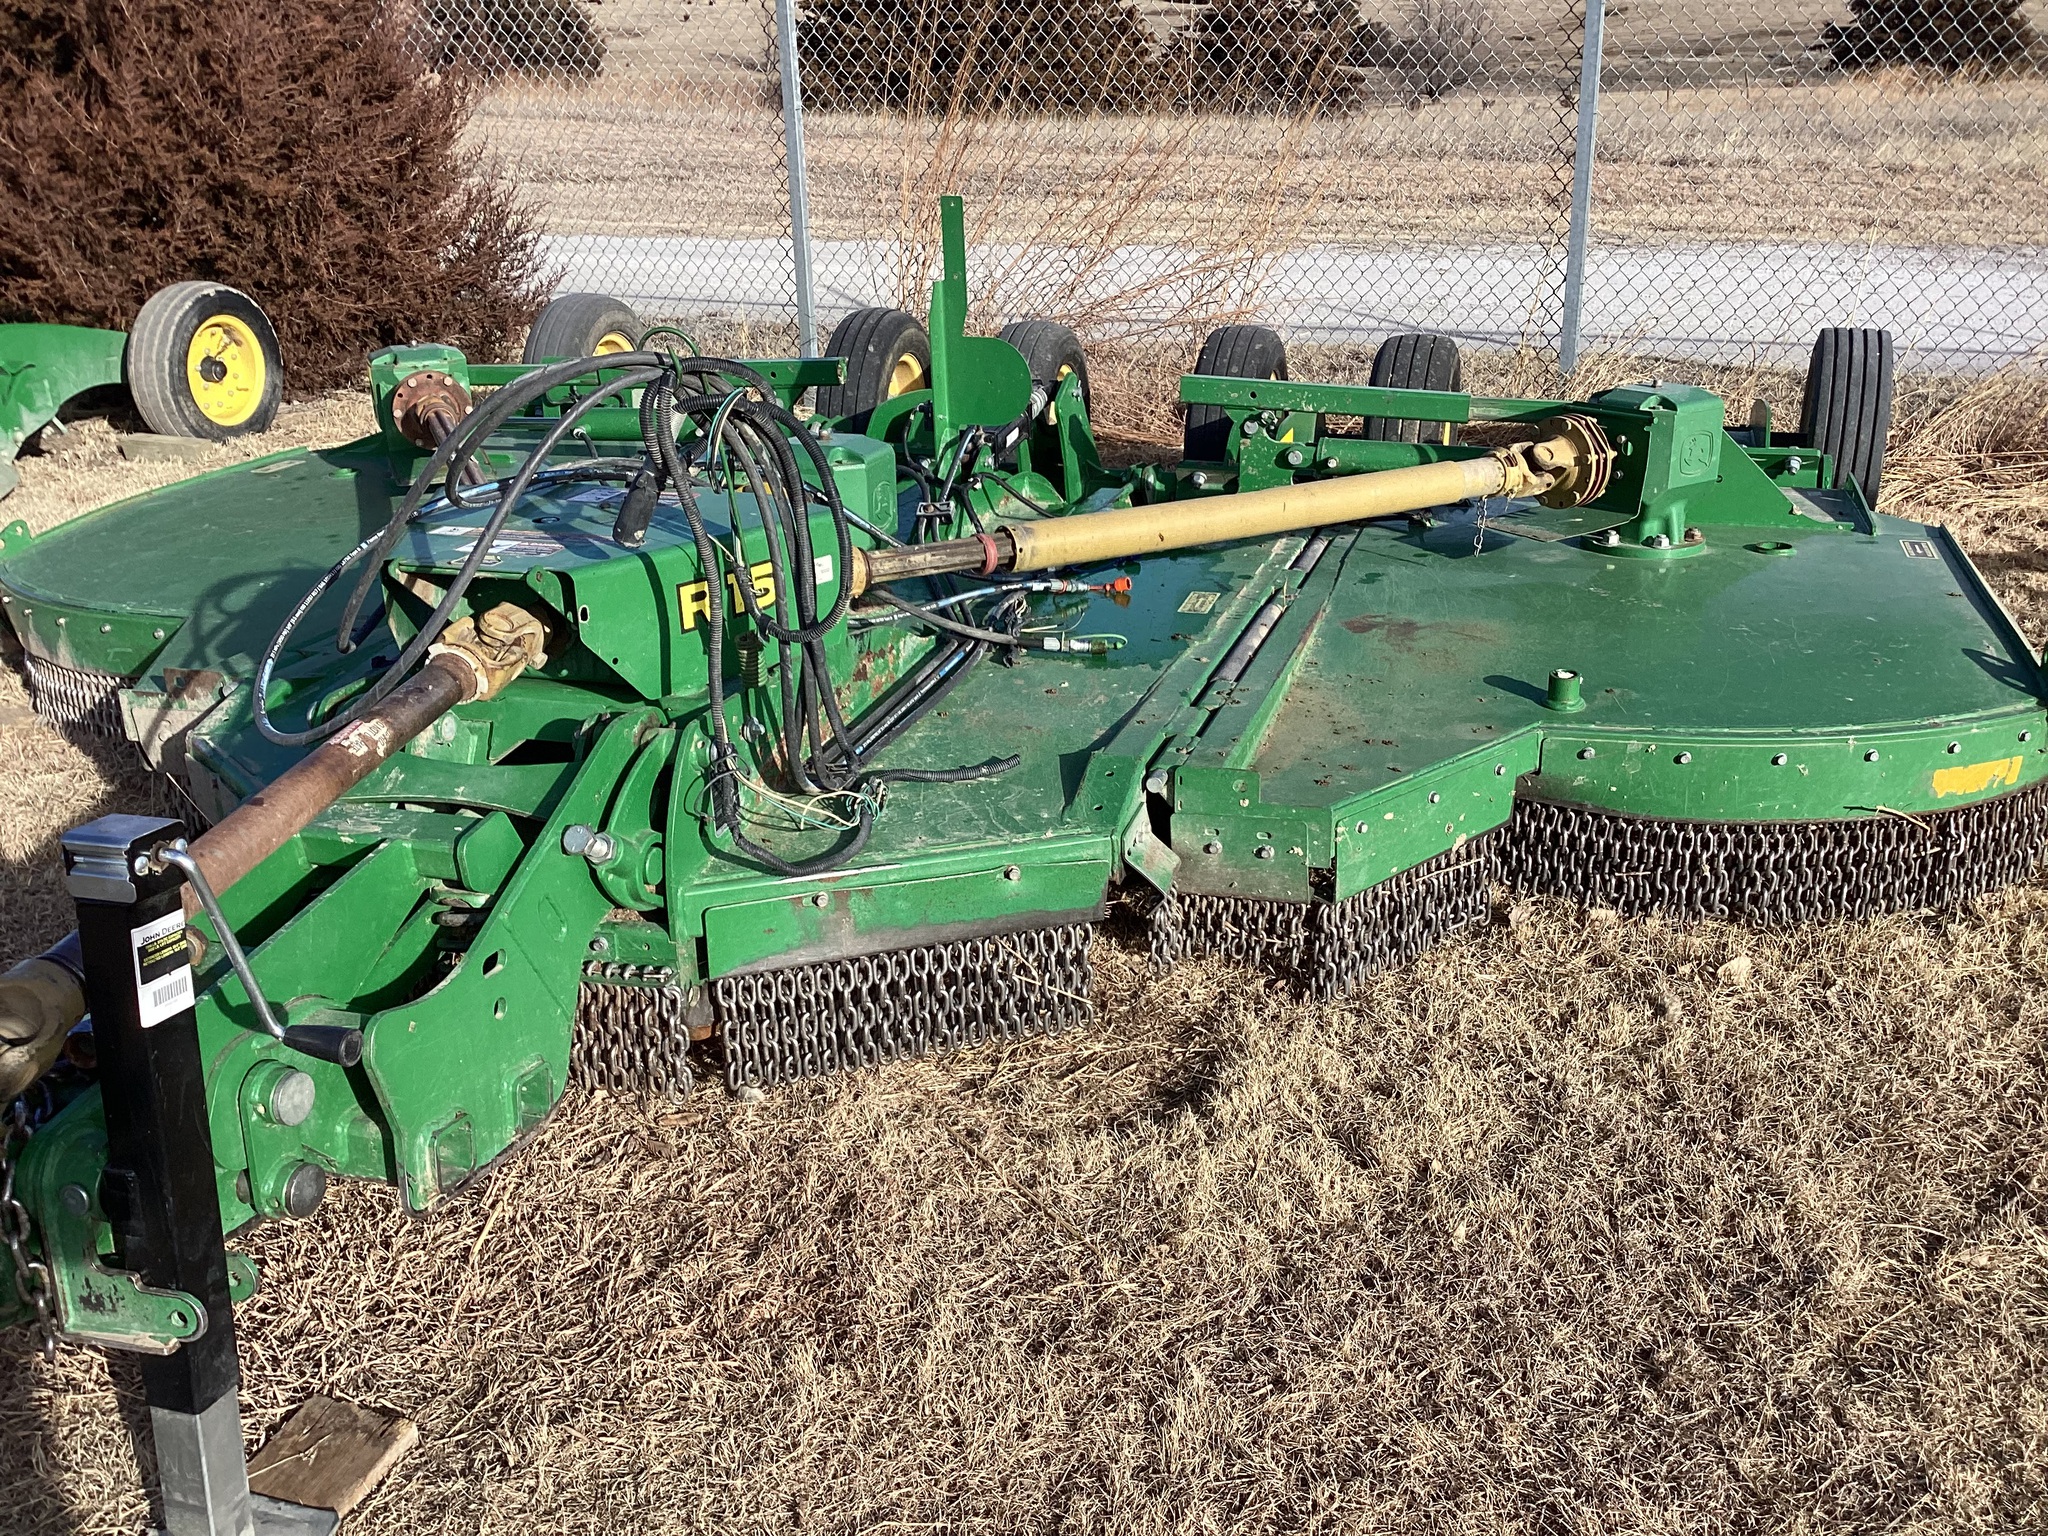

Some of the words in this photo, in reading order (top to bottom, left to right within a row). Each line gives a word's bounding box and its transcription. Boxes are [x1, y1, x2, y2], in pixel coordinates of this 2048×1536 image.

[676, 558, 777, 634] R15
[141, 931, 161, 946] JOHN
[162, 921, 184, 936] DEERE
